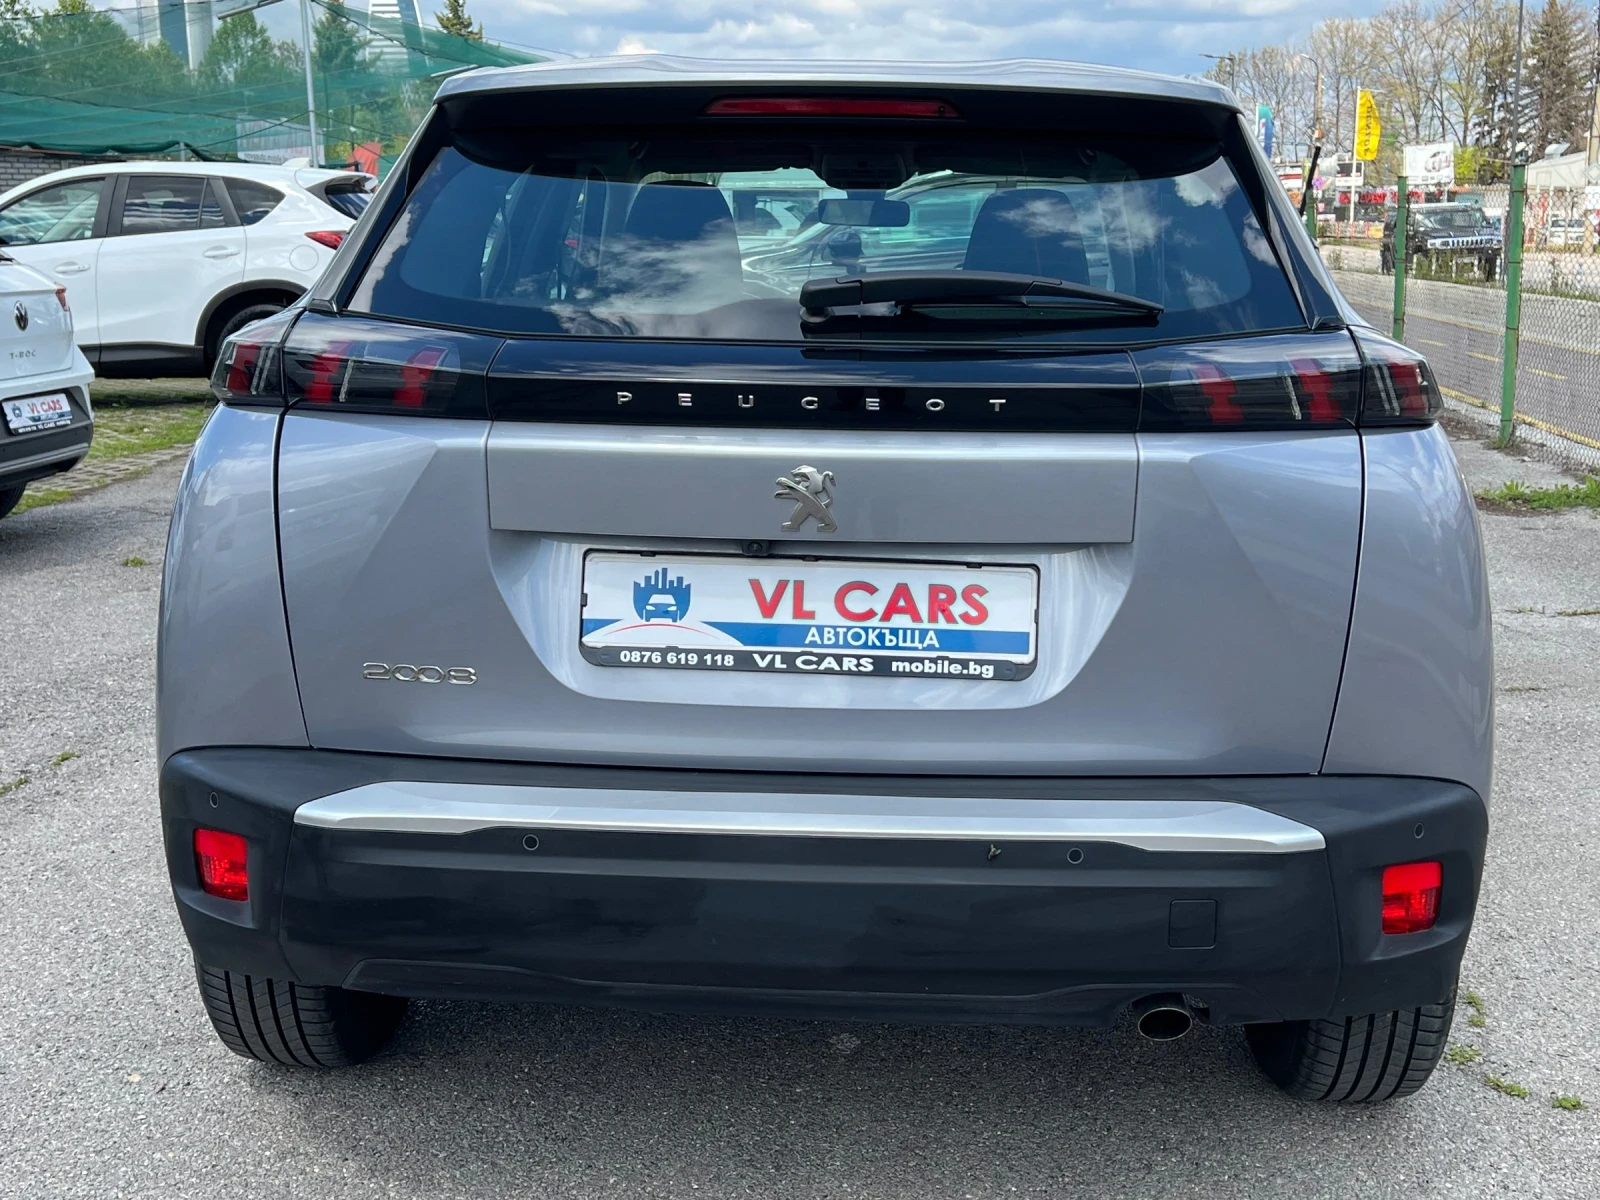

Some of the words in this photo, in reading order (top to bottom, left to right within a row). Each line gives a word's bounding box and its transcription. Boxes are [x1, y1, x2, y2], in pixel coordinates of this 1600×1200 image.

[27, 402, 41, 415] VL
[40, 399, 63, 413] CARS
[616, 391, 1007, 412] PEUGEOT
[748, 578, 816, 620] VL
[834, 580, 989, 625] CARS
[804, 626, 940, 649] АВТОКЪЩА
[363, 662, 479, 684] 2008
[619, 650, 662, 664] 0876
[666, 651, 699, 666] 619
[703, 653, 735, 667] 118
[752, 654, 788, 669] VL
[795, 655, 874, 672] CARS
[891, 658, 995, 679] mobile.bg
